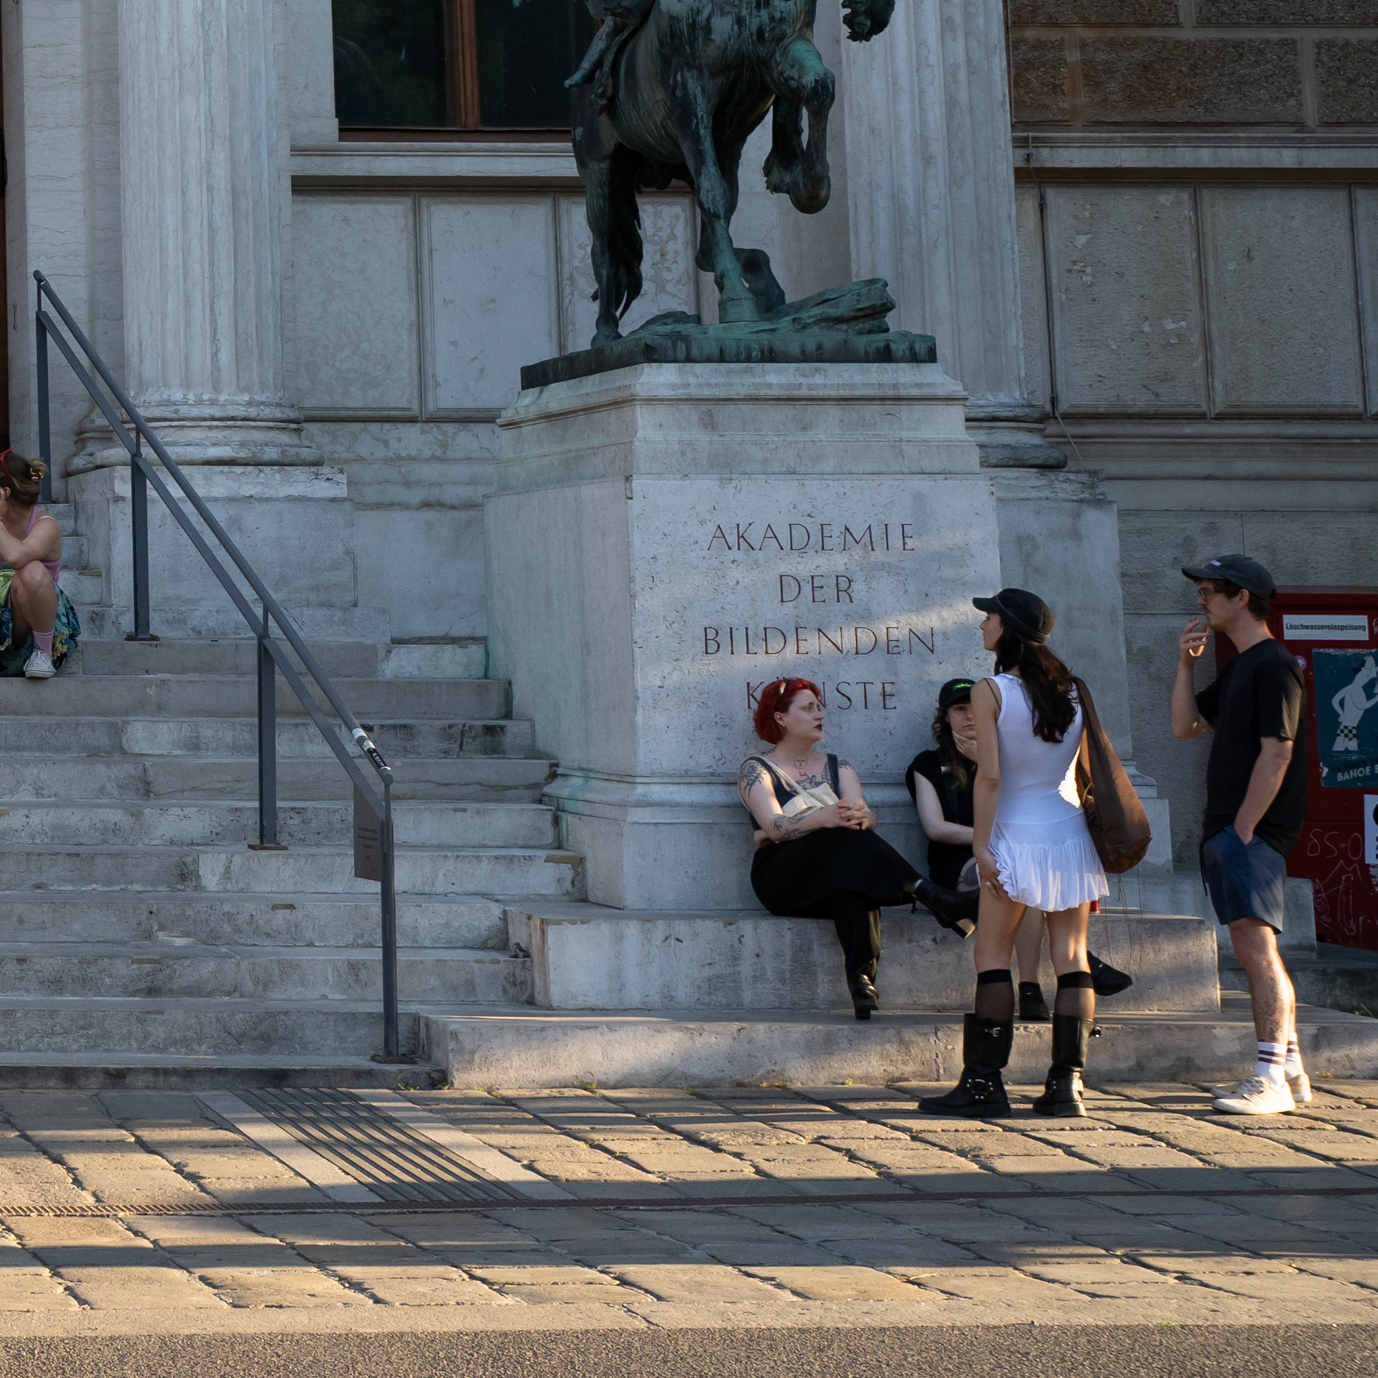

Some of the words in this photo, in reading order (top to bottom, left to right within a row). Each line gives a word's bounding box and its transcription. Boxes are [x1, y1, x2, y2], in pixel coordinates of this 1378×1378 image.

[707, 523, 915, 551] AKADEMIE
[779, 574, 854, 604] DER
[1285, 622, 1366, 631] Löschwassereinspeisung
[704, 627, 935, 655] BILDENDEN
[1337, 766, 1371, 782] BAHOE
